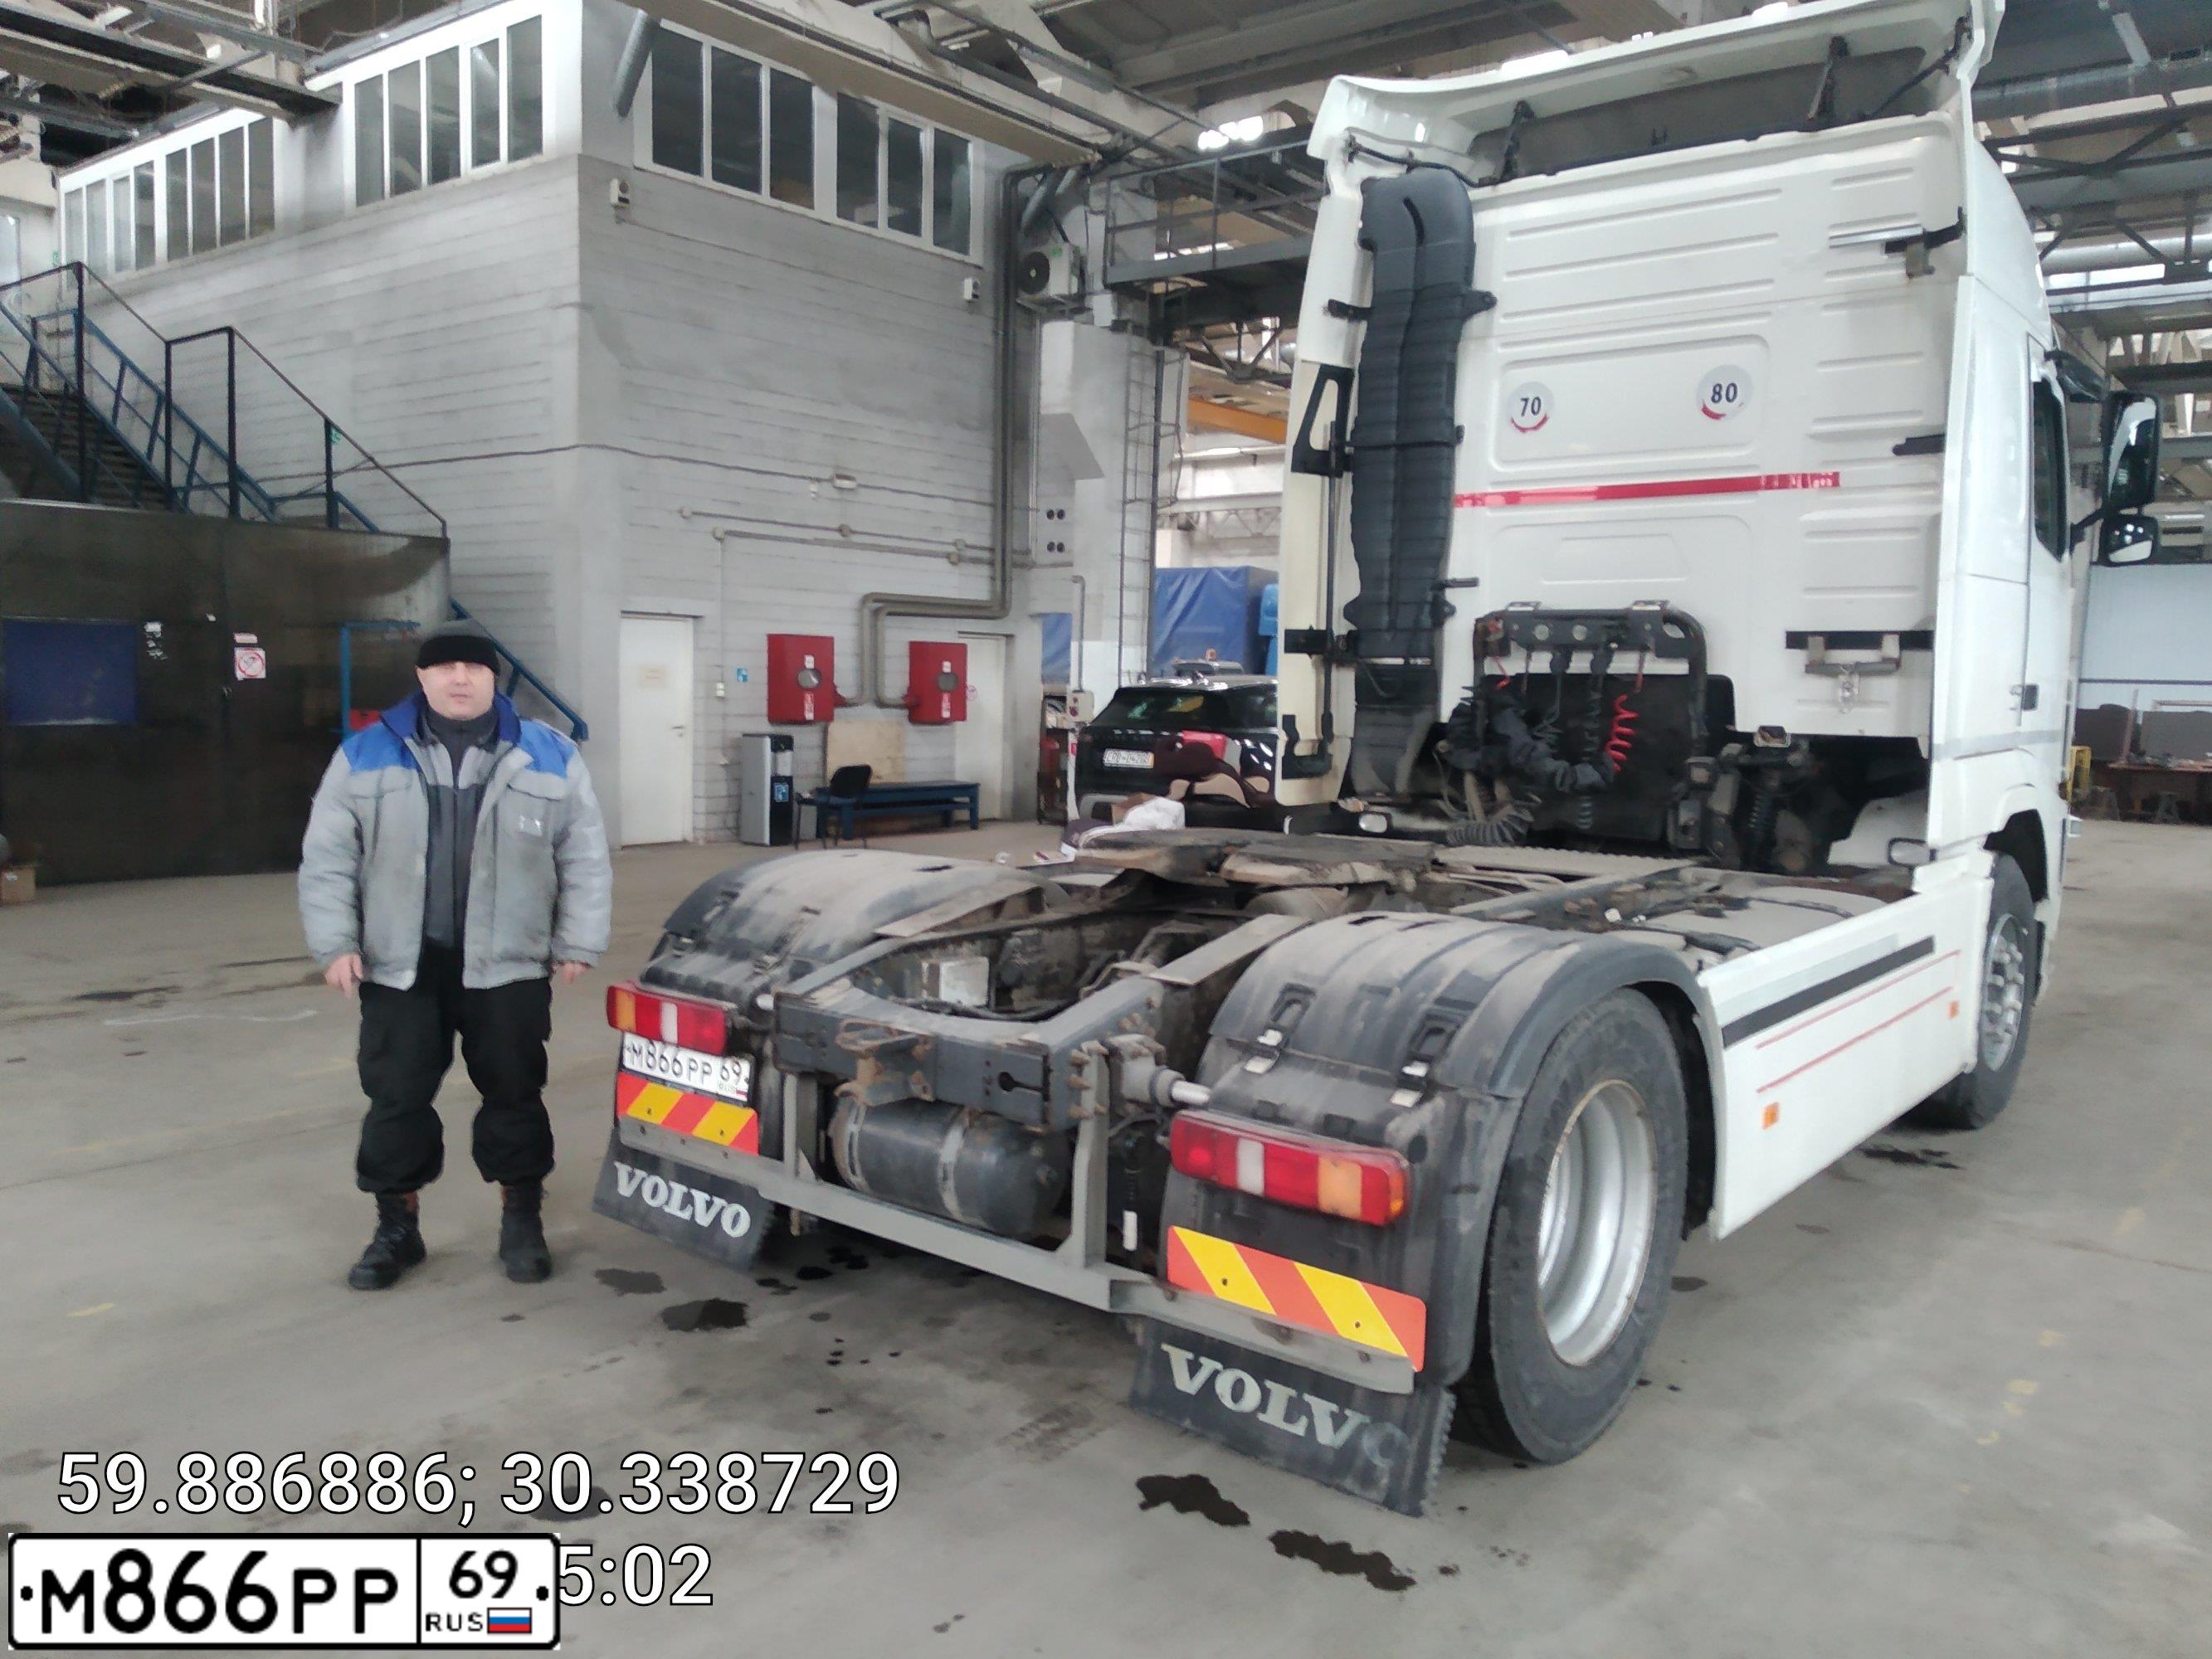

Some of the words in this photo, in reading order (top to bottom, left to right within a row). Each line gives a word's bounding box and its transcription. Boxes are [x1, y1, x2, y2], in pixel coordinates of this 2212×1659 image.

[1710, 382, 1738, 403] 80
[1519, 397, 1542, 417] 70
[613, 1160, 752, 1238] VOLVO
